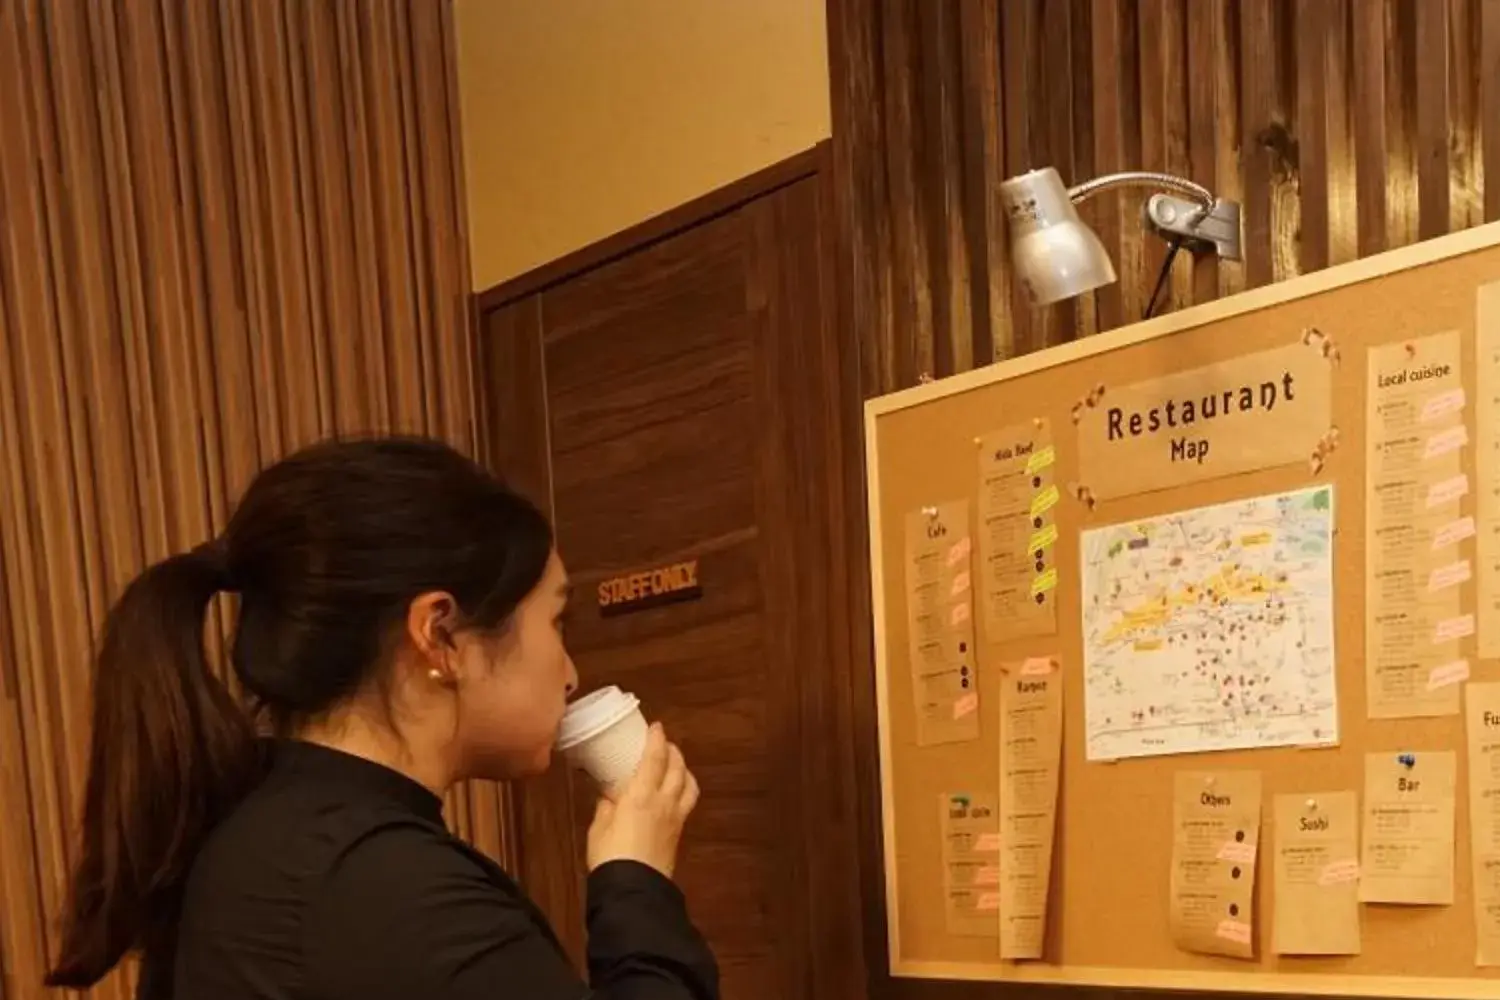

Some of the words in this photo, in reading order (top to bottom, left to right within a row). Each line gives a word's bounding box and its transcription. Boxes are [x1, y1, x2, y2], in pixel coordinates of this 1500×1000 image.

[1378, 371, 1407, 389] Local
[1409, 364, 1451, 384] cuisine
[1107, 371, 1295, 441] Restaurant
[1170, 437, 1209, 465] Map
[597, 571, 652, 607] STAFF
[1397, 777, 1421, 792] Bar
[1199, 792, 1231, 807] Others
[1299, 817, 1330, 832] Sushi
